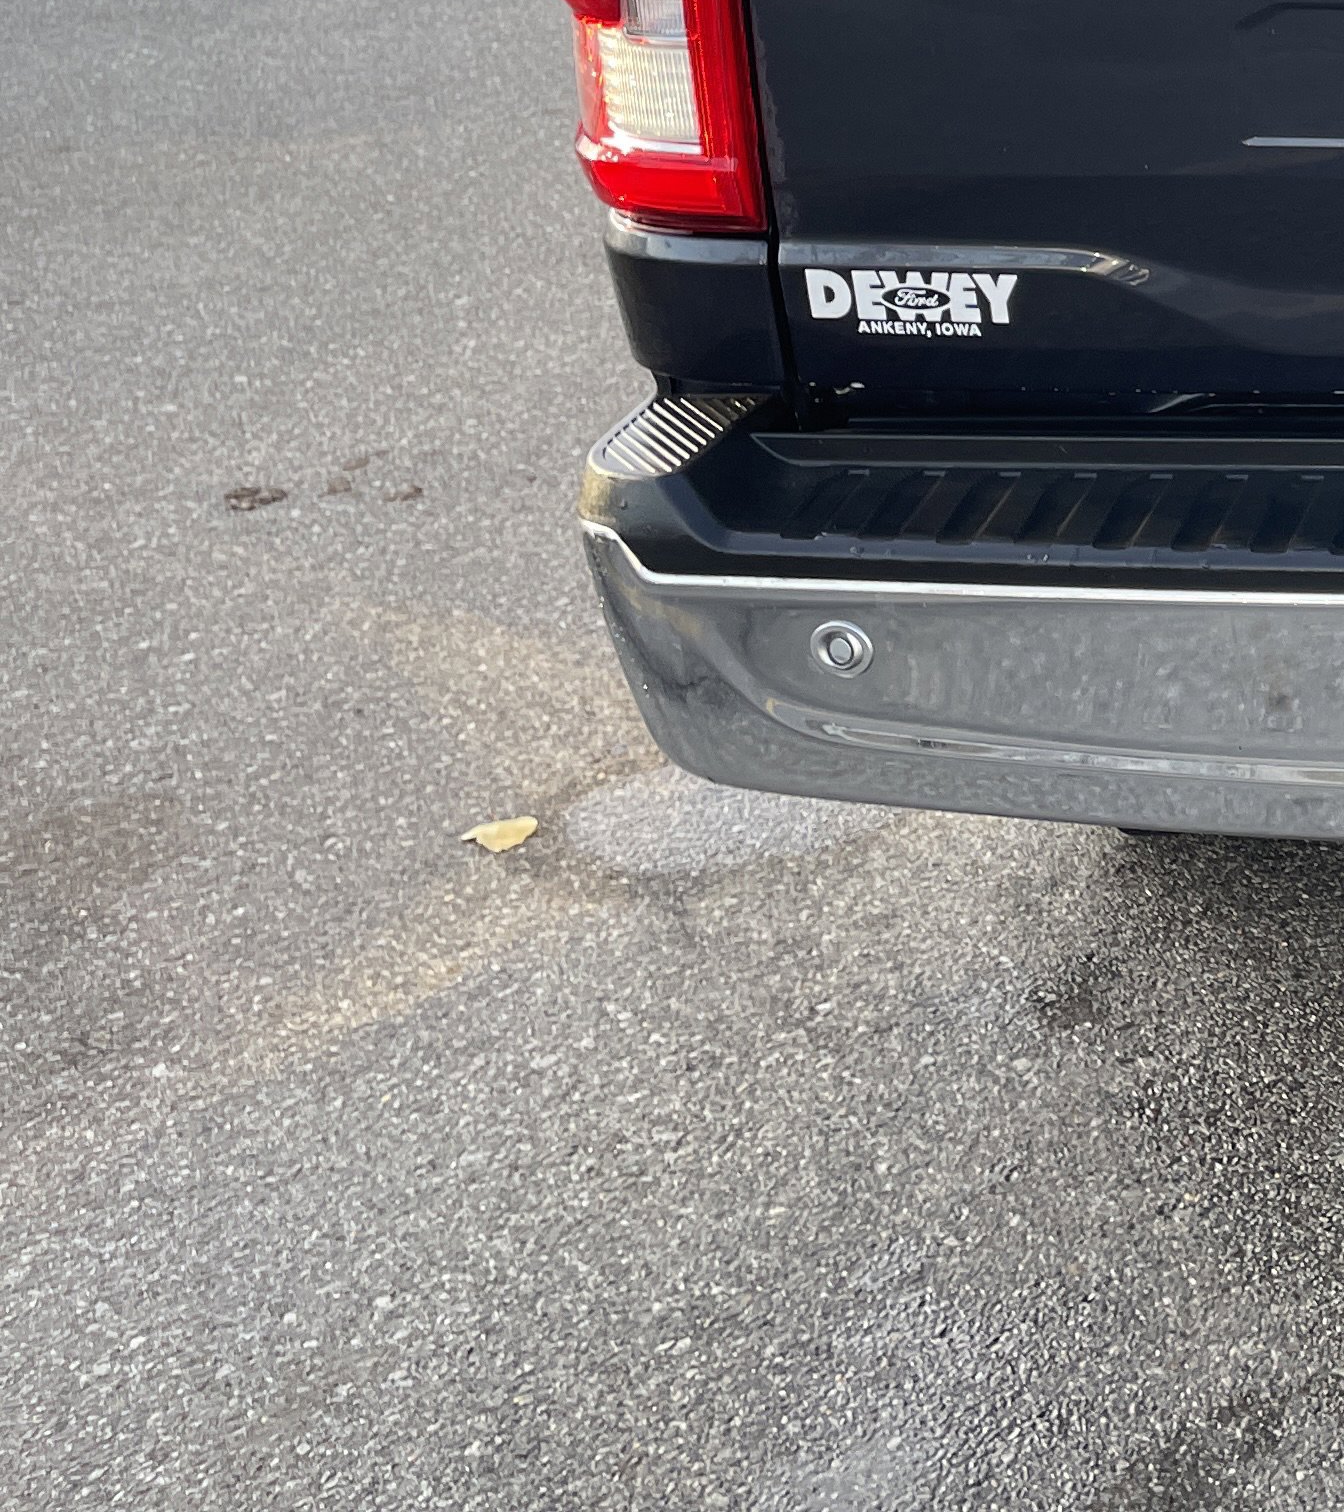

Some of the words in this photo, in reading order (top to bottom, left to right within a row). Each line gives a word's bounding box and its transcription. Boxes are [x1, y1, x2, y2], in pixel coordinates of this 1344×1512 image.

[804, 268, 1018, 324] DEWEY
[894, 288, 940, 308] Ford
[857, 320, 932, 338] ANKENY,
[935, 323, 982, 337] IOWA
